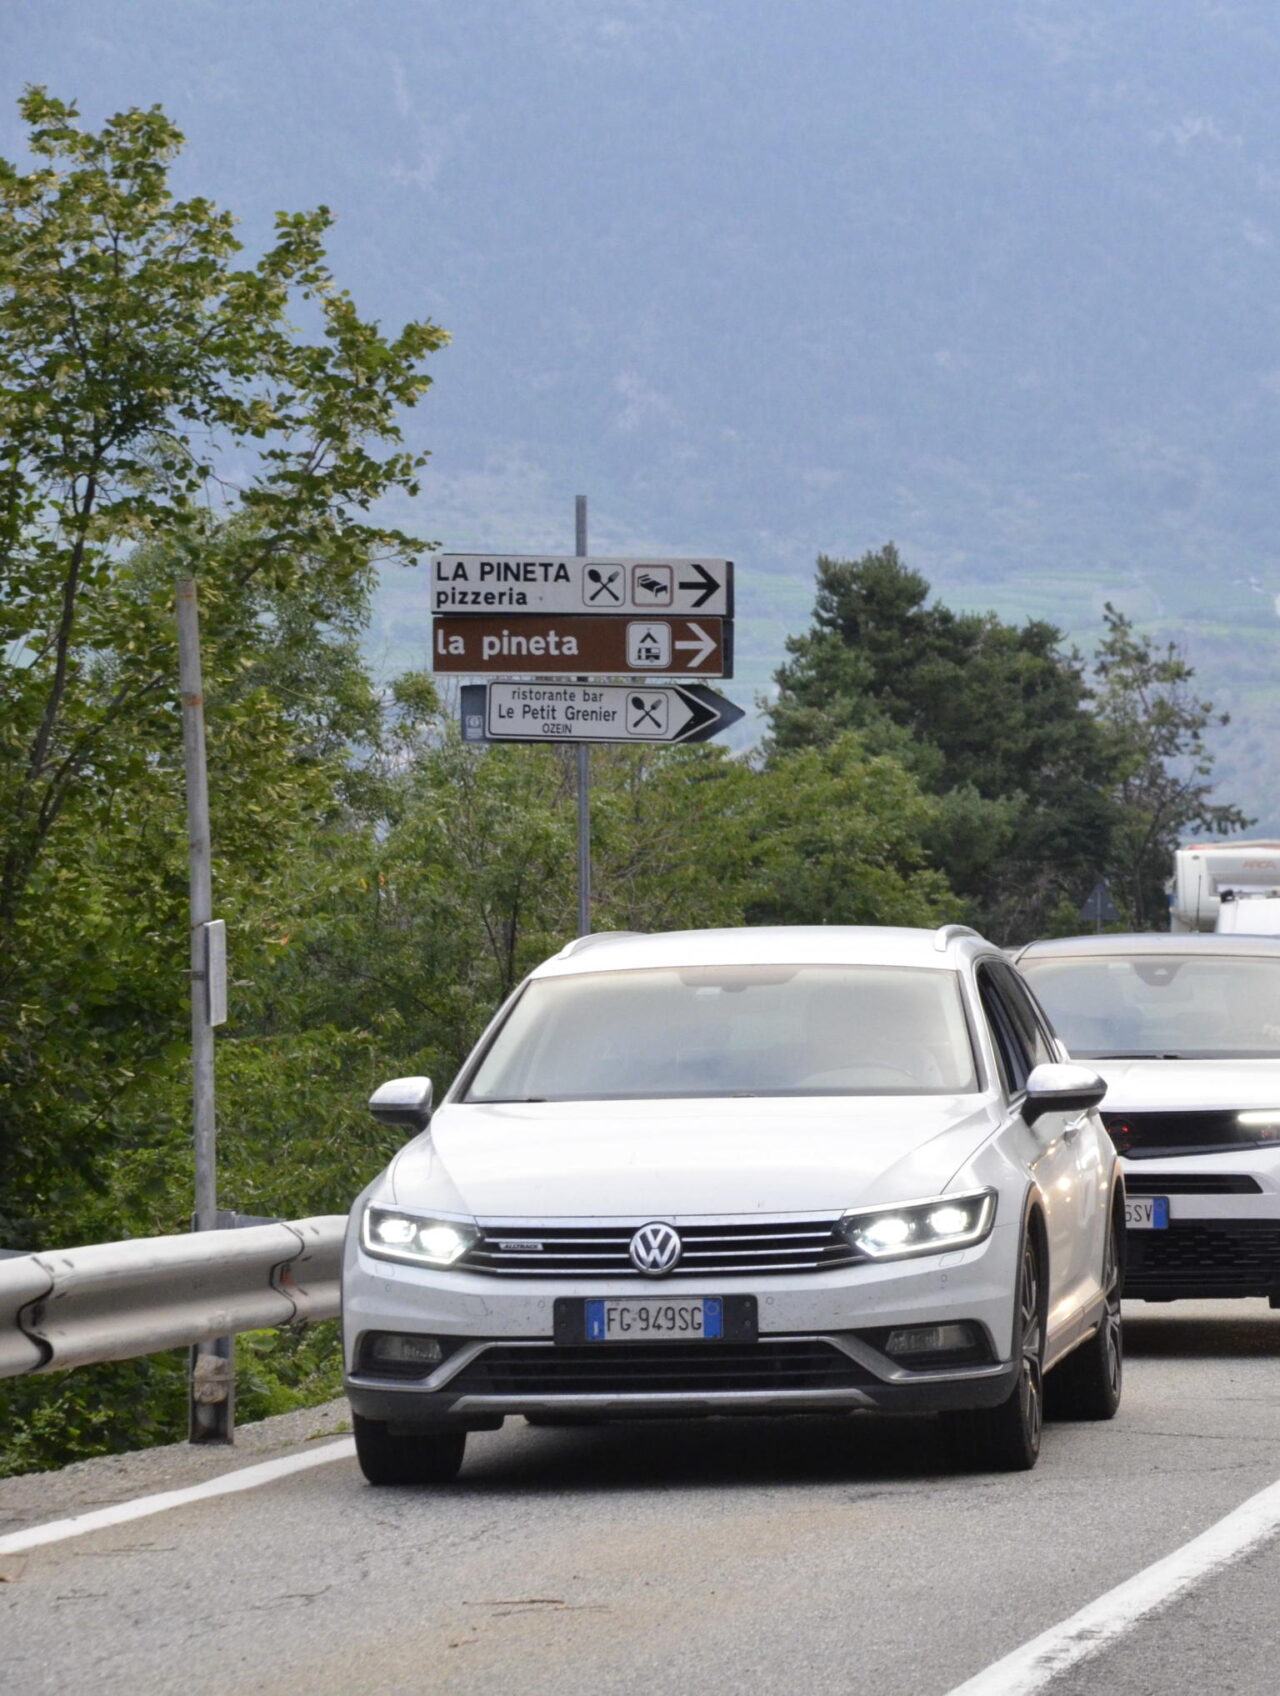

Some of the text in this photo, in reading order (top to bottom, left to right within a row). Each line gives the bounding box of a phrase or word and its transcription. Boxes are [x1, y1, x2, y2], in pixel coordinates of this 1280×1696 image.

[436, 561, 571, 583] LA PINETA
[436, 586, 528, 608] pizzeria
[437, 629, 579, 660] la pineta
[511, 687, 604, 703] ristorante bar
[498, 703, 617, 722] Le Petit Grenier
[542, 723, 573, 735] OZEIN
